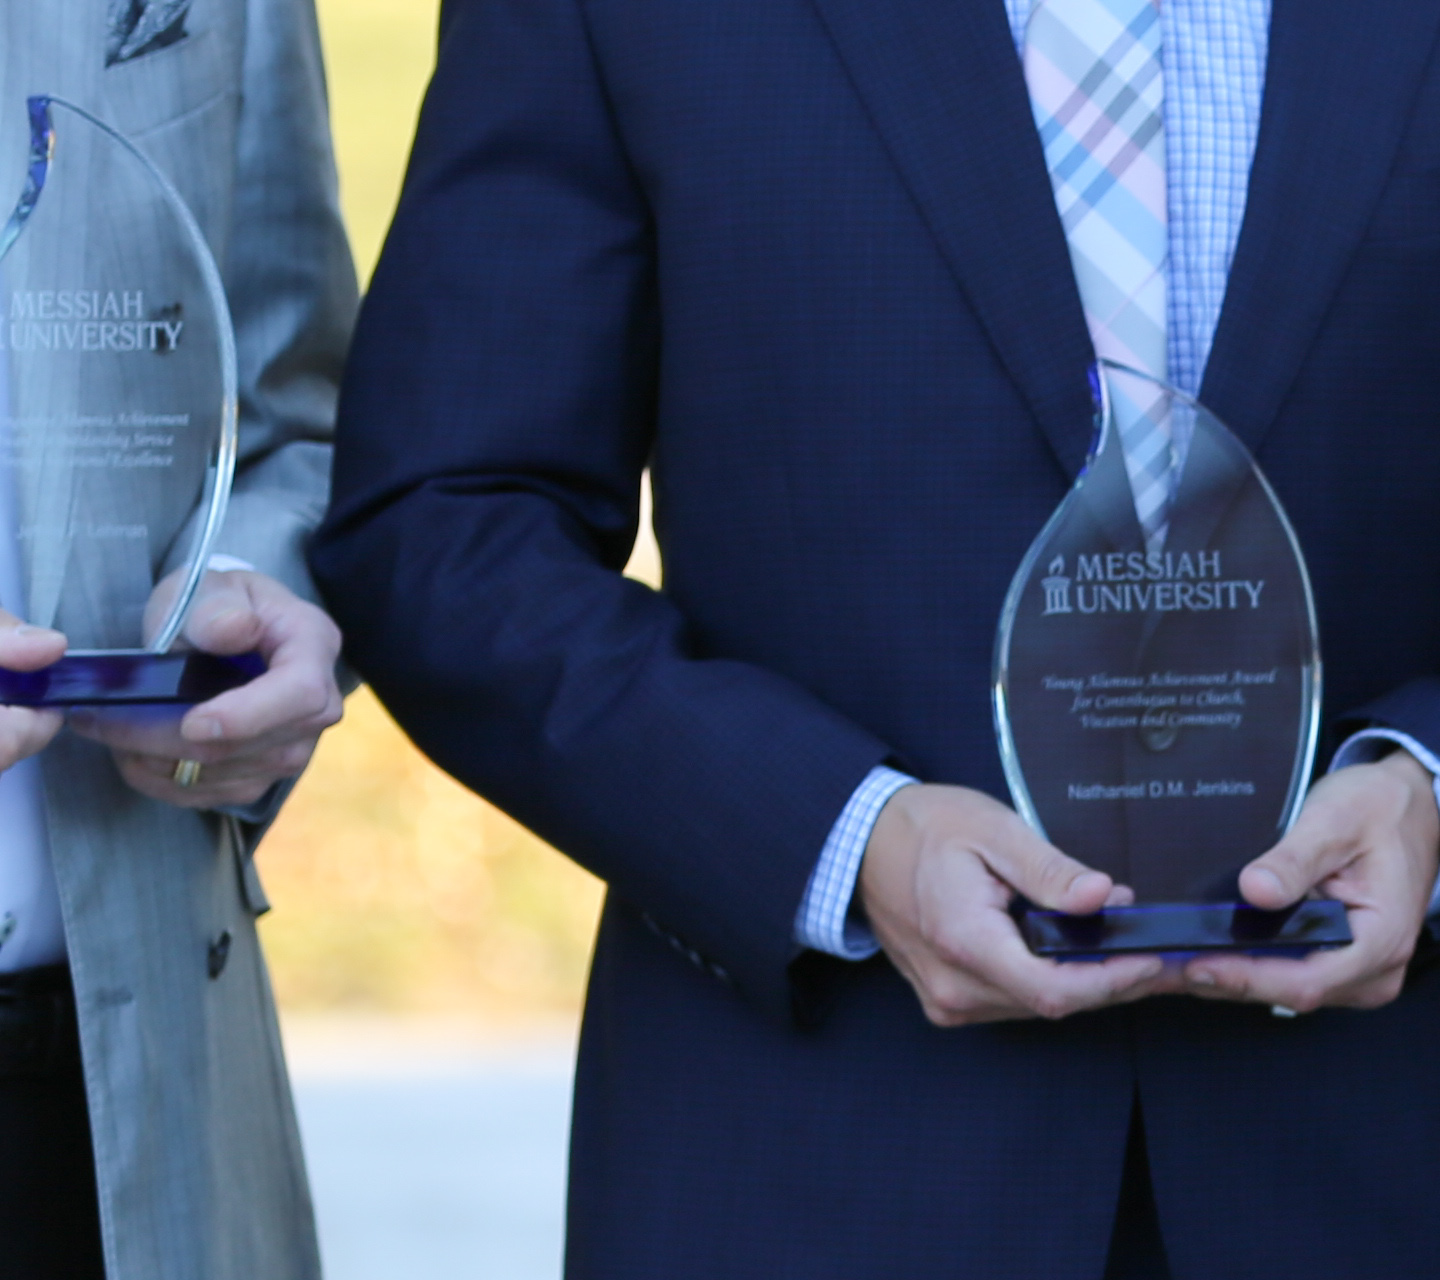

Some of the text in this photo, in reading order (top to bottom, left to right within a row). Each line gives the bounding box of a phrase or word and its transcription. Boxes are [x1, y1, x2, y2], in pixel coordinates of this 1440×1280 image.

[10, 290, 144, 320] MESSIAH
[10, 320, 184, 352] UNIVERSITY
[1076, 550, 1221, 582] MESSIAH
[1076, 579, 1265, 614] UNIVERSITY
[1147, 670, 1229, 688] Achievement
[1230, 666, 1279, 686] Award
[1069, 694, 1093, 714] for
[1179, 693, 1195, 706] to
[1080, 713, 1138, 730] Vocation
[1167, 710, 1243, 731] Community
[1067, 781, 1146, 801] Nathaniel
[1192, 778, 1257, 797] Jenkins
